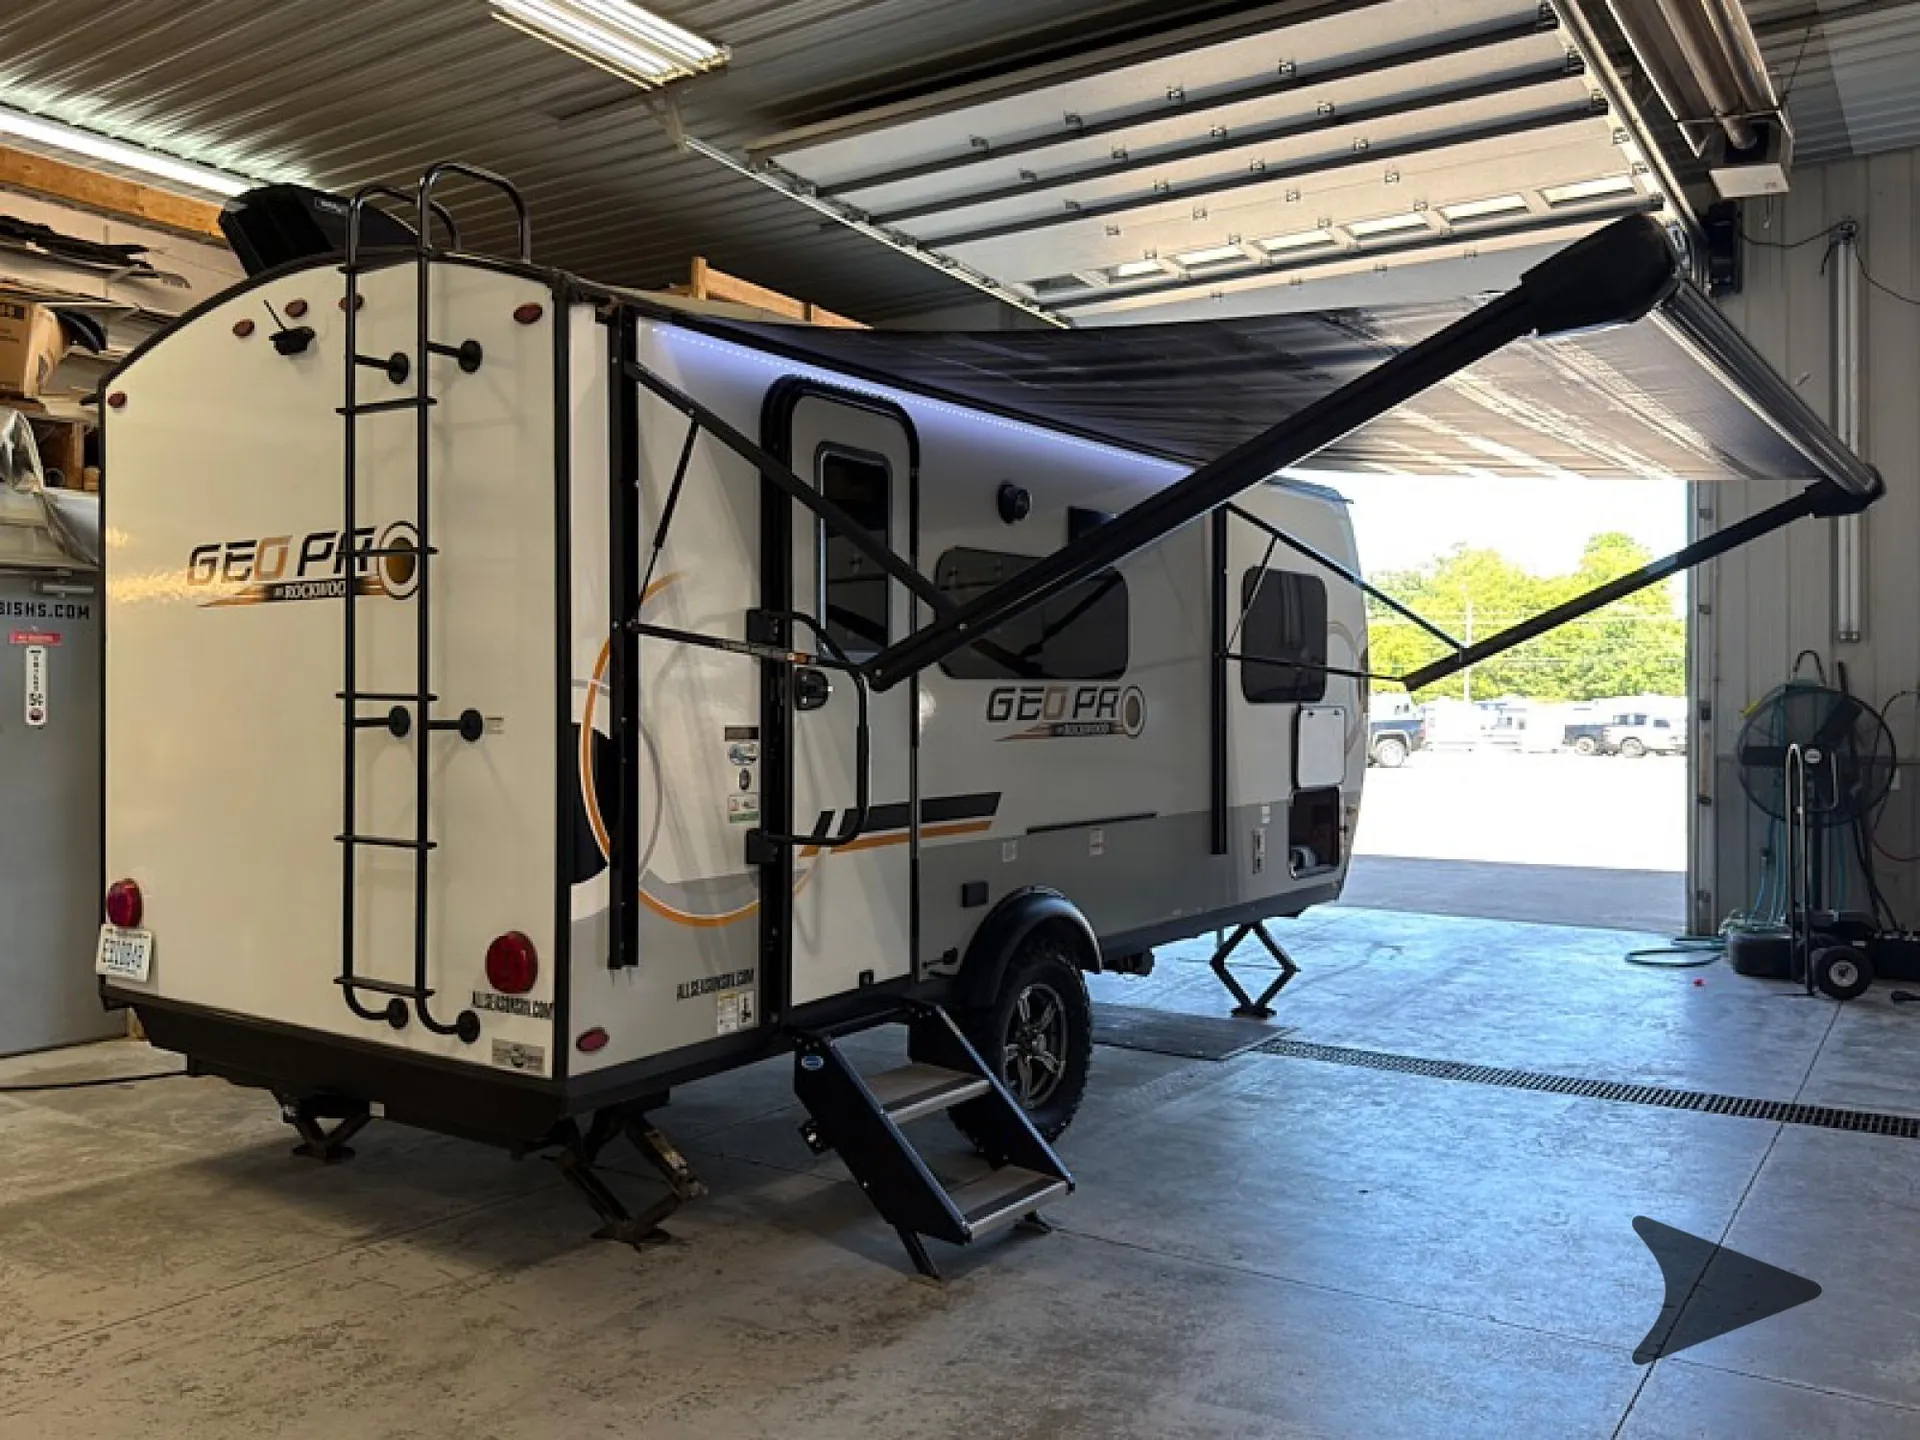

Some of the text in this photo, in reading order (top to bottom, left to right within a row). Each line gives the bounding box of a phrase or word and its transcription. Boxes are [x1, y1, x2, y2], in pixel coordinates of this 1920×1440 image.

[187, 536, 293, 586] GEO
[986, 684, 1146, 739] GEO PRO
